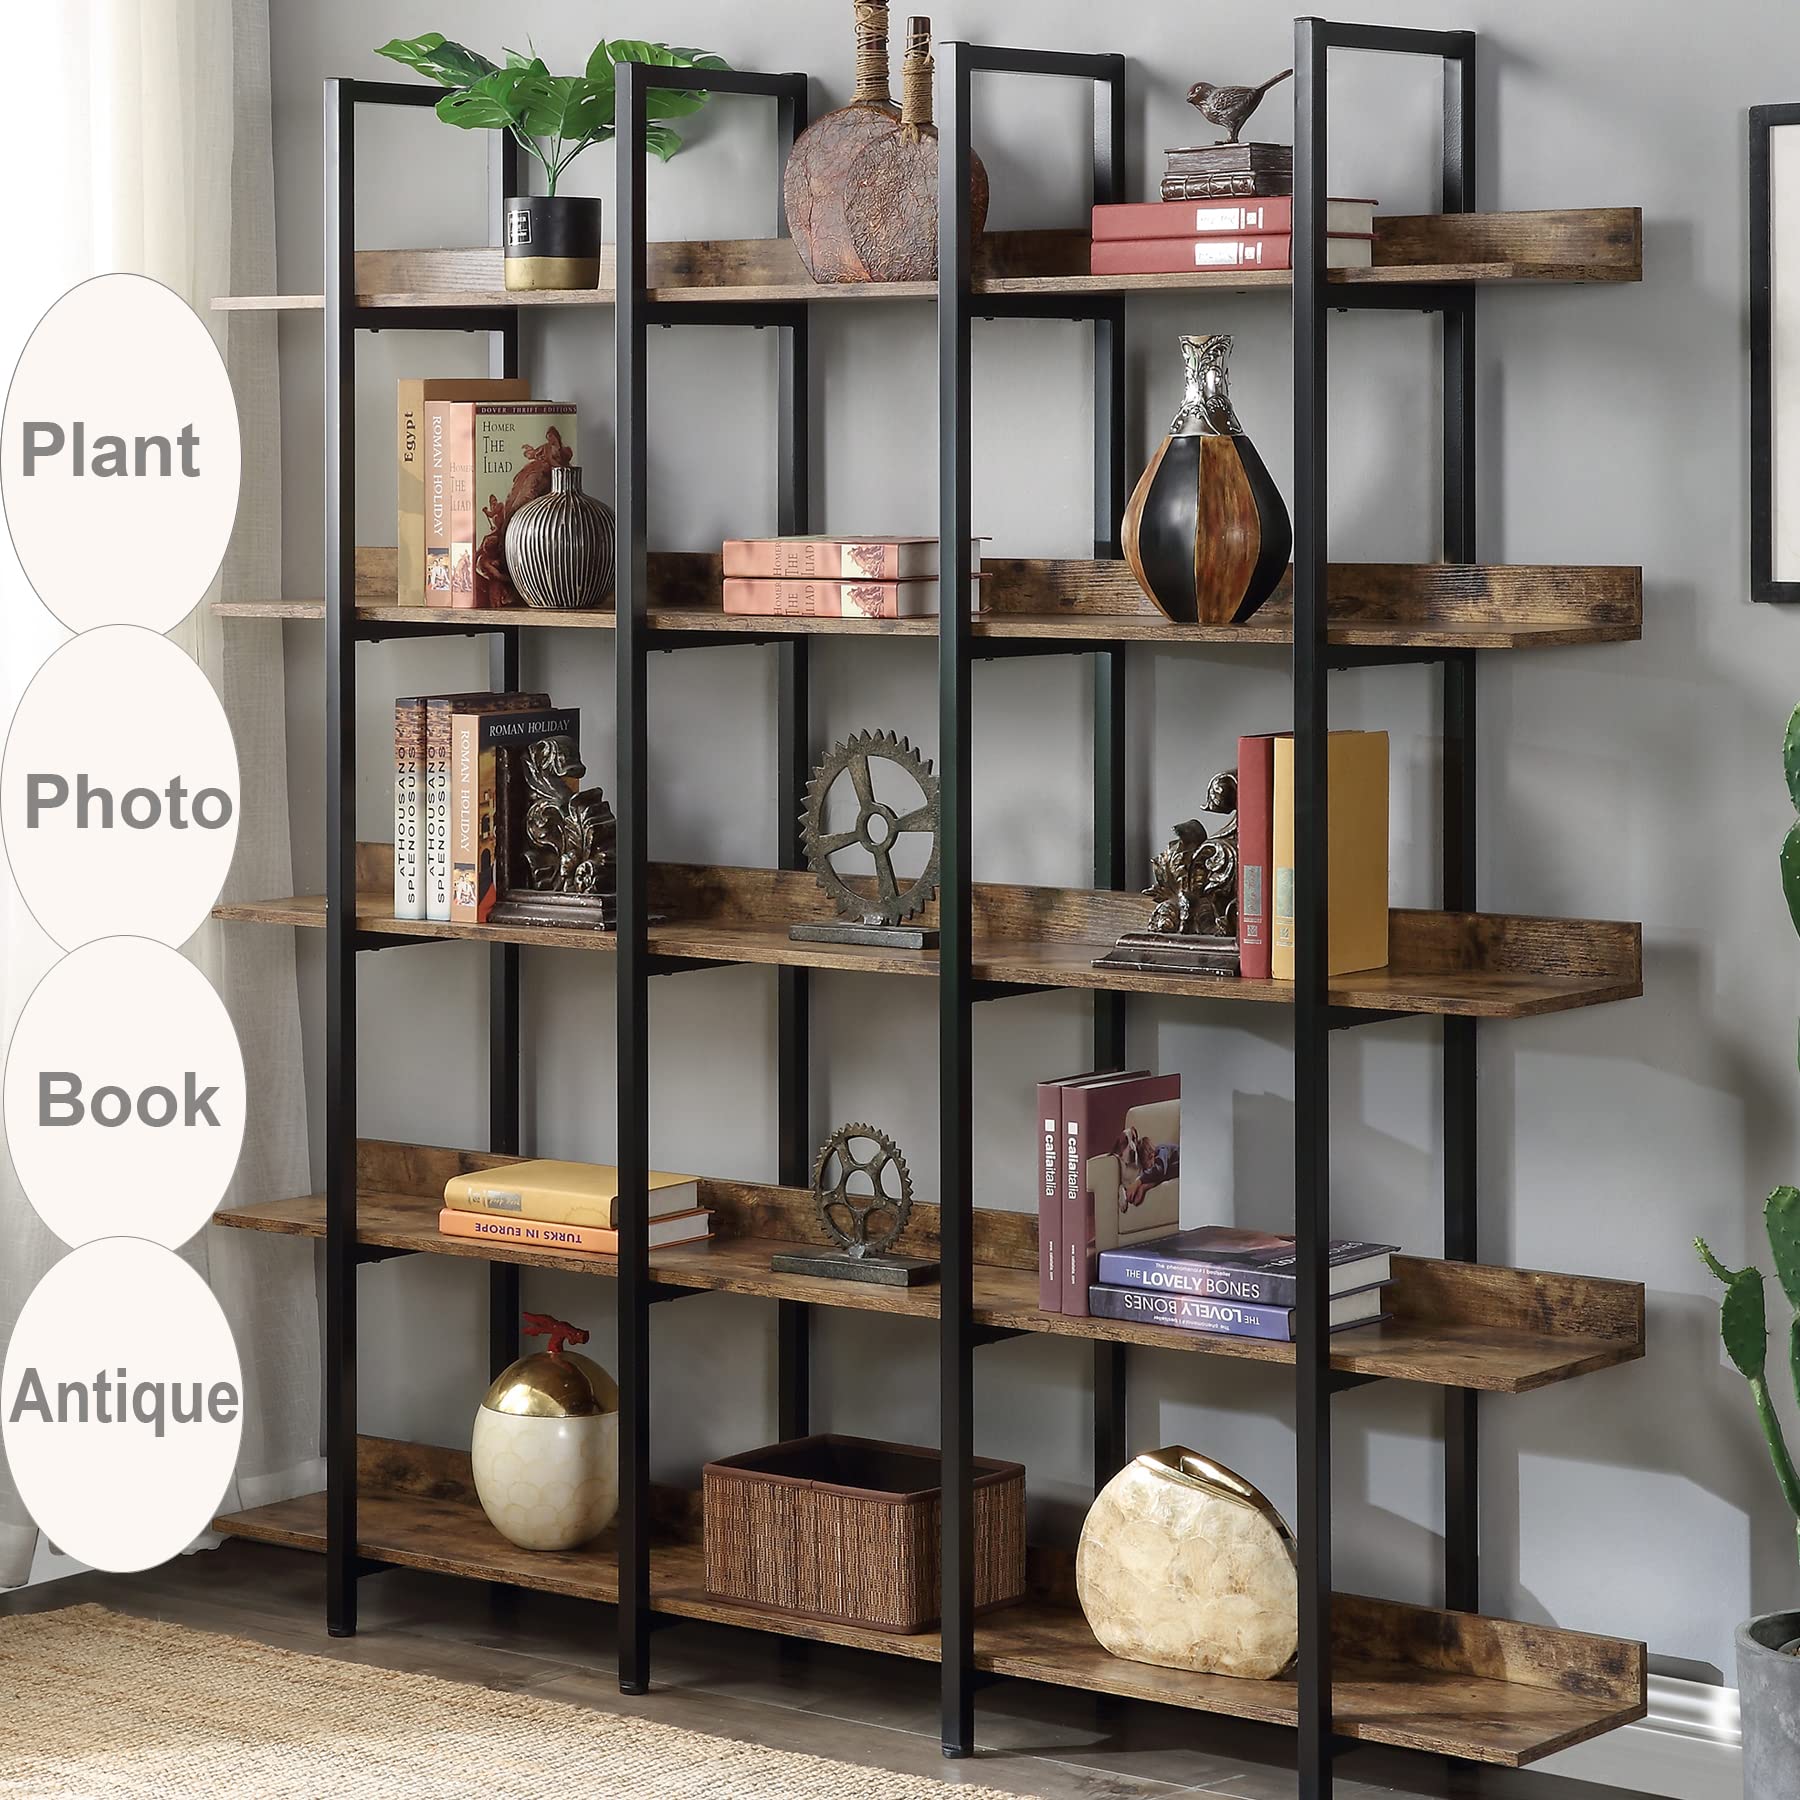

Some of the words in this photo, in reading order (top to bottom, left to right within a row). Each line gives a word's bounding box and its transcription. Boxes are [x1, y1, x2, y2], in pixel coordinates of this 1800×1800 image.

[404, 411, 416, 462] Egypt
[432, 415, 442, 468] ROMAN
[482, 436, 505, 454] THE
[483, 456, 513, 474] ILIAD
[449, 476, 466, 492] THE
[432, 475, 443, 536] HOLIDAY
[785, 553, 799, 577] THE
[785, 593, 799, 615] THE
[489, 722, 525, 737] ROMAN
[528, 719, 570, 734] HOLIDAY
[460, 730, 470, 783] ROMAN
[460, 788, 470, 852] HOLIDAY
[475, 1222, 521, 1236] EUROPE
[526, 1228, 539, 1238] IN
[543, 1230, 582, 1243] TURKS
[1125, 1268, 1141, 1279] THE
[1143, 1270, 1202, 1291] LOVELY
[1206, 1279, 1260, 1299] BONES
[1125, 1294, 1177, 1314] BONES
[1181, 1302, 1242, 1323] LOVELY
[1244, 1316, 1260, 1326] THE
